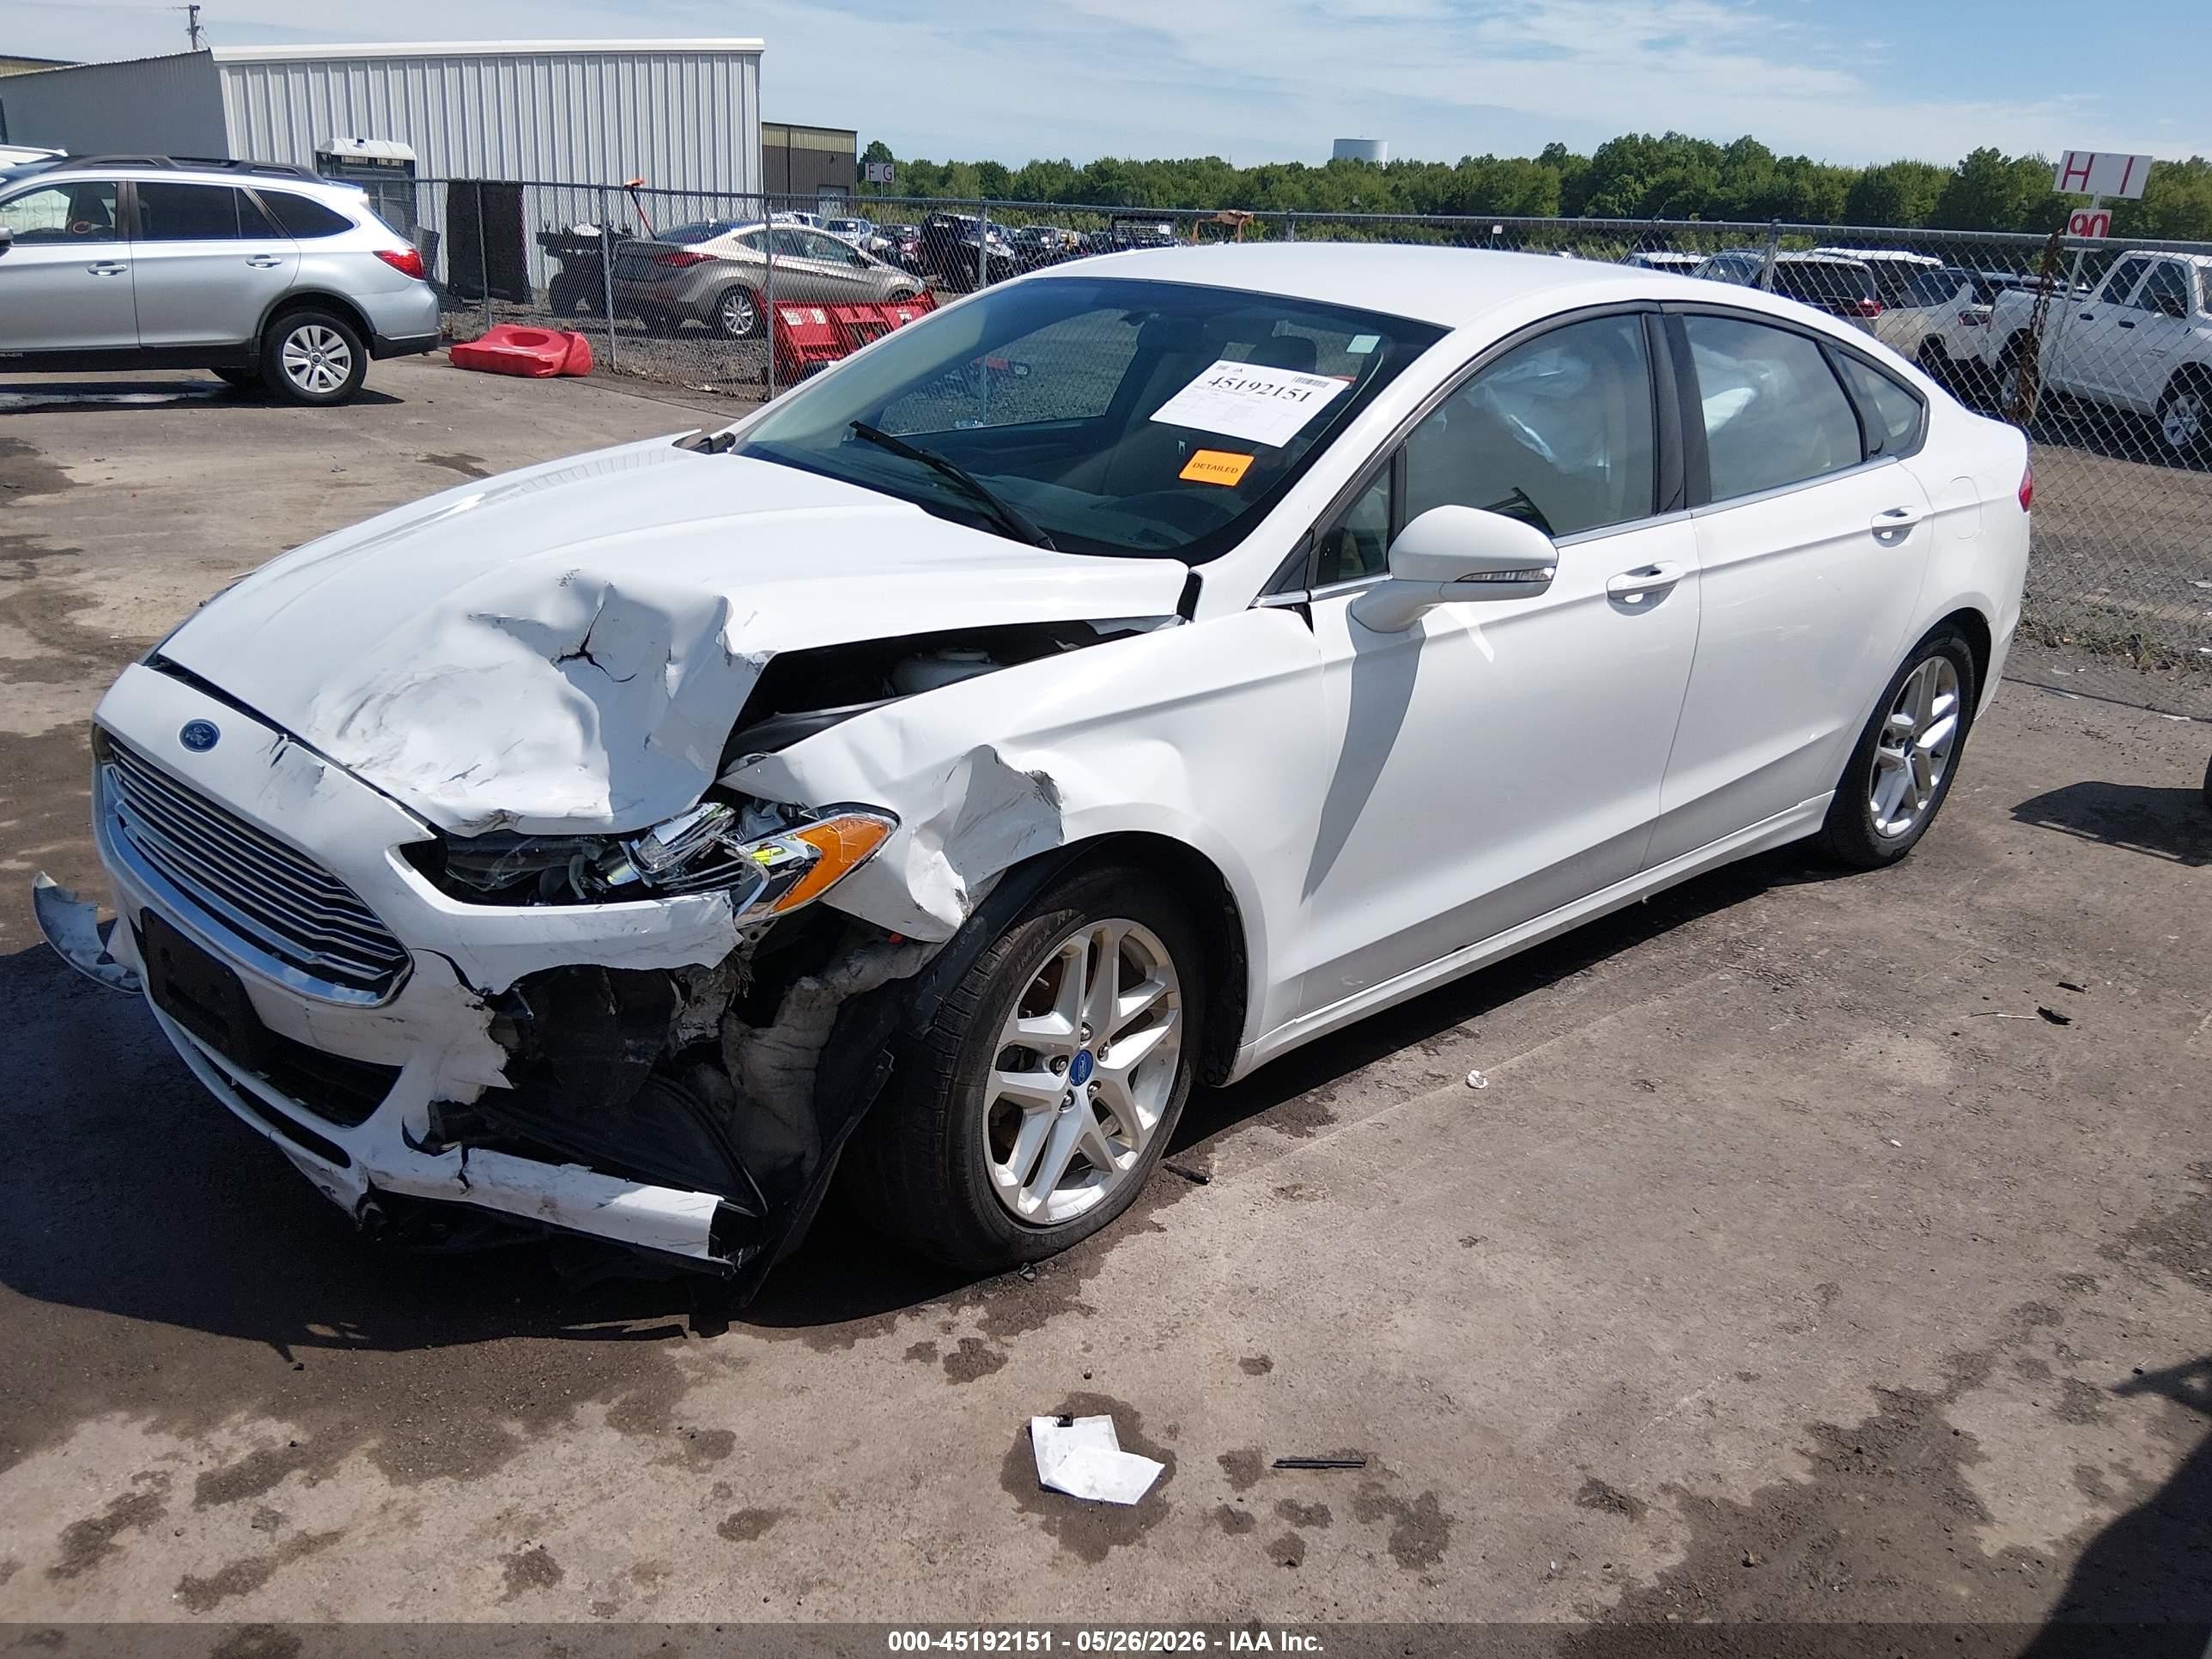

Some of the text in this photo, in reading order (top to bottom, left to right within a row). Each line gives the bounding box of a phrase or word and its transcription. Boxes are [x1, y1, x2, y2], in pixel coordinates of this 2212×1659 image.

[868, 164, 893, 181] F G
[2061, 152, 2095, 192] H
[1207, 376, 1313, 402] 45192151
[1192, 462, 1239, 474] DETAILED
